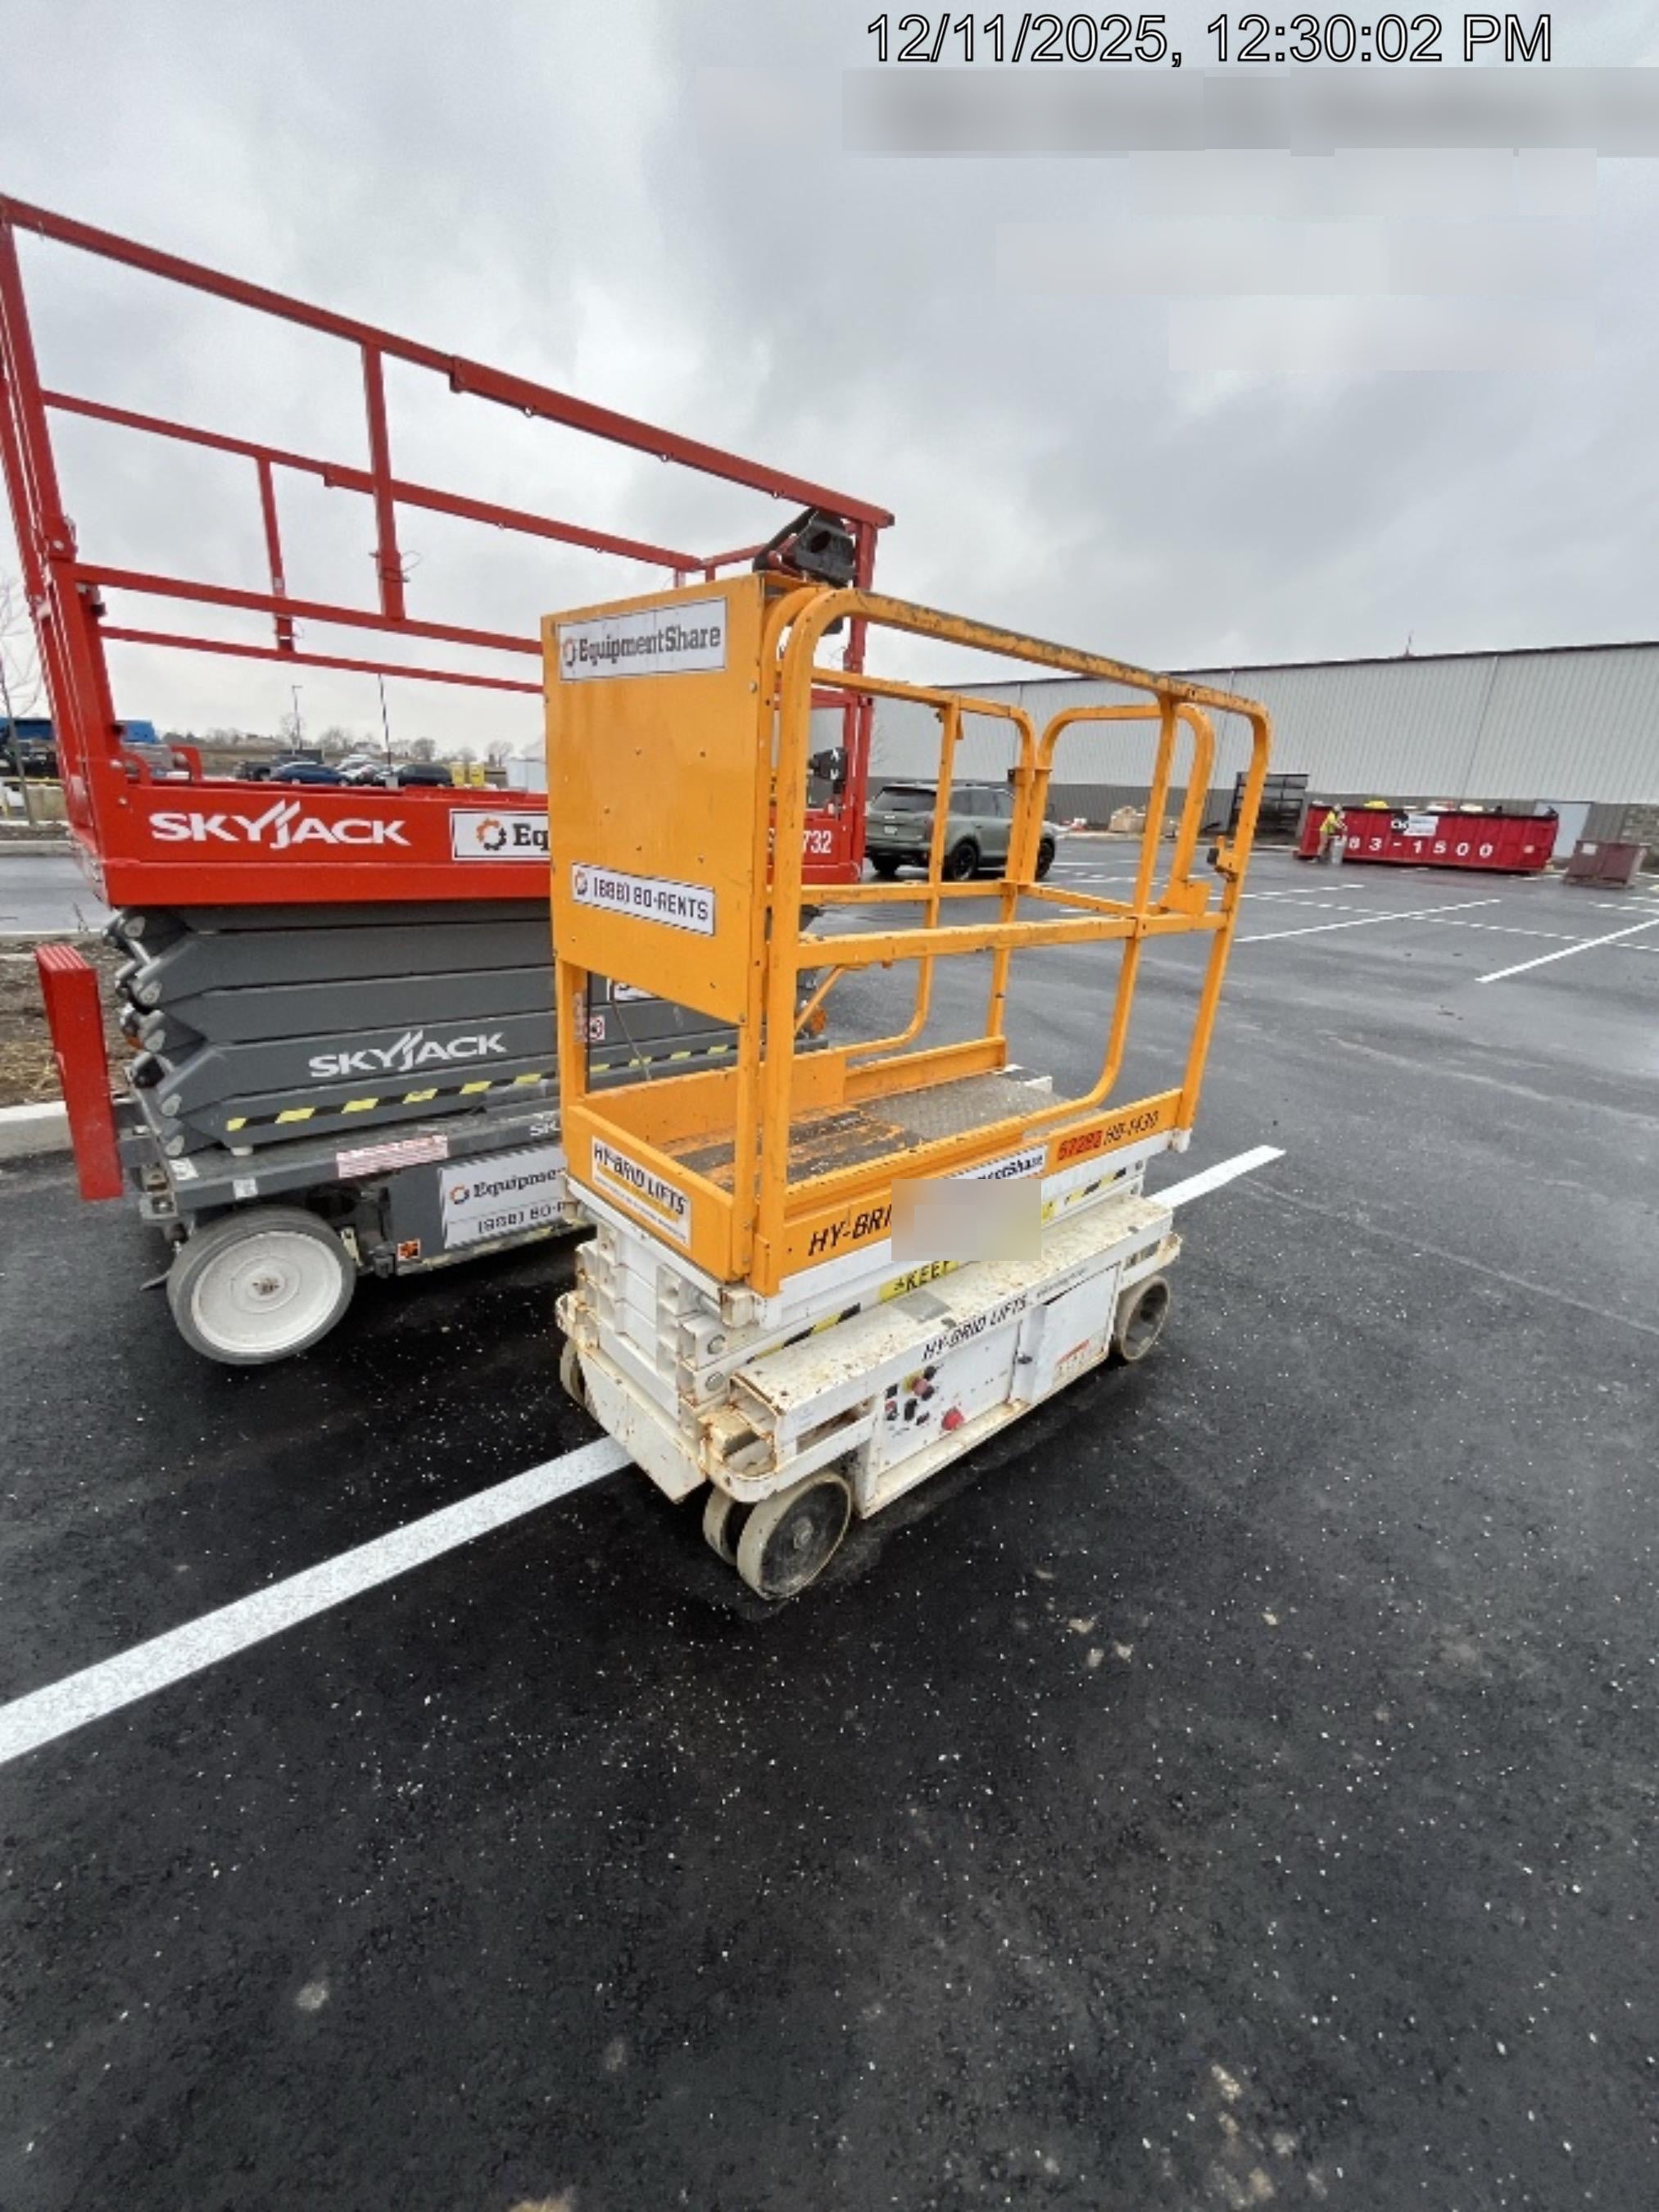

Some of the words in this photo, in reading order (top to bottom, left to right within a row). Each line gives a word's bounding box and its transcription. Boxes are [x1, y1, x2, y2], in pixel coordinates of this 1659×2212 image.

[579, 626, 721, 666] EquipmentShare
[149, 800, 411, 849] SKYJACK
[513, 823, 549, 850] Eq
[802, 829, 832, 854] 732
[594, 877, 630, 904] (888)
[633, 886, 709, 922] 80-RENTS
[309, 1029, 508, 1077] SKYJACK
[474, 1165, 566, 1198] Equipme
[808, 1203, 892, 1257] HY-BRI
[990, 1292, 1028, 1326] LIFTS
